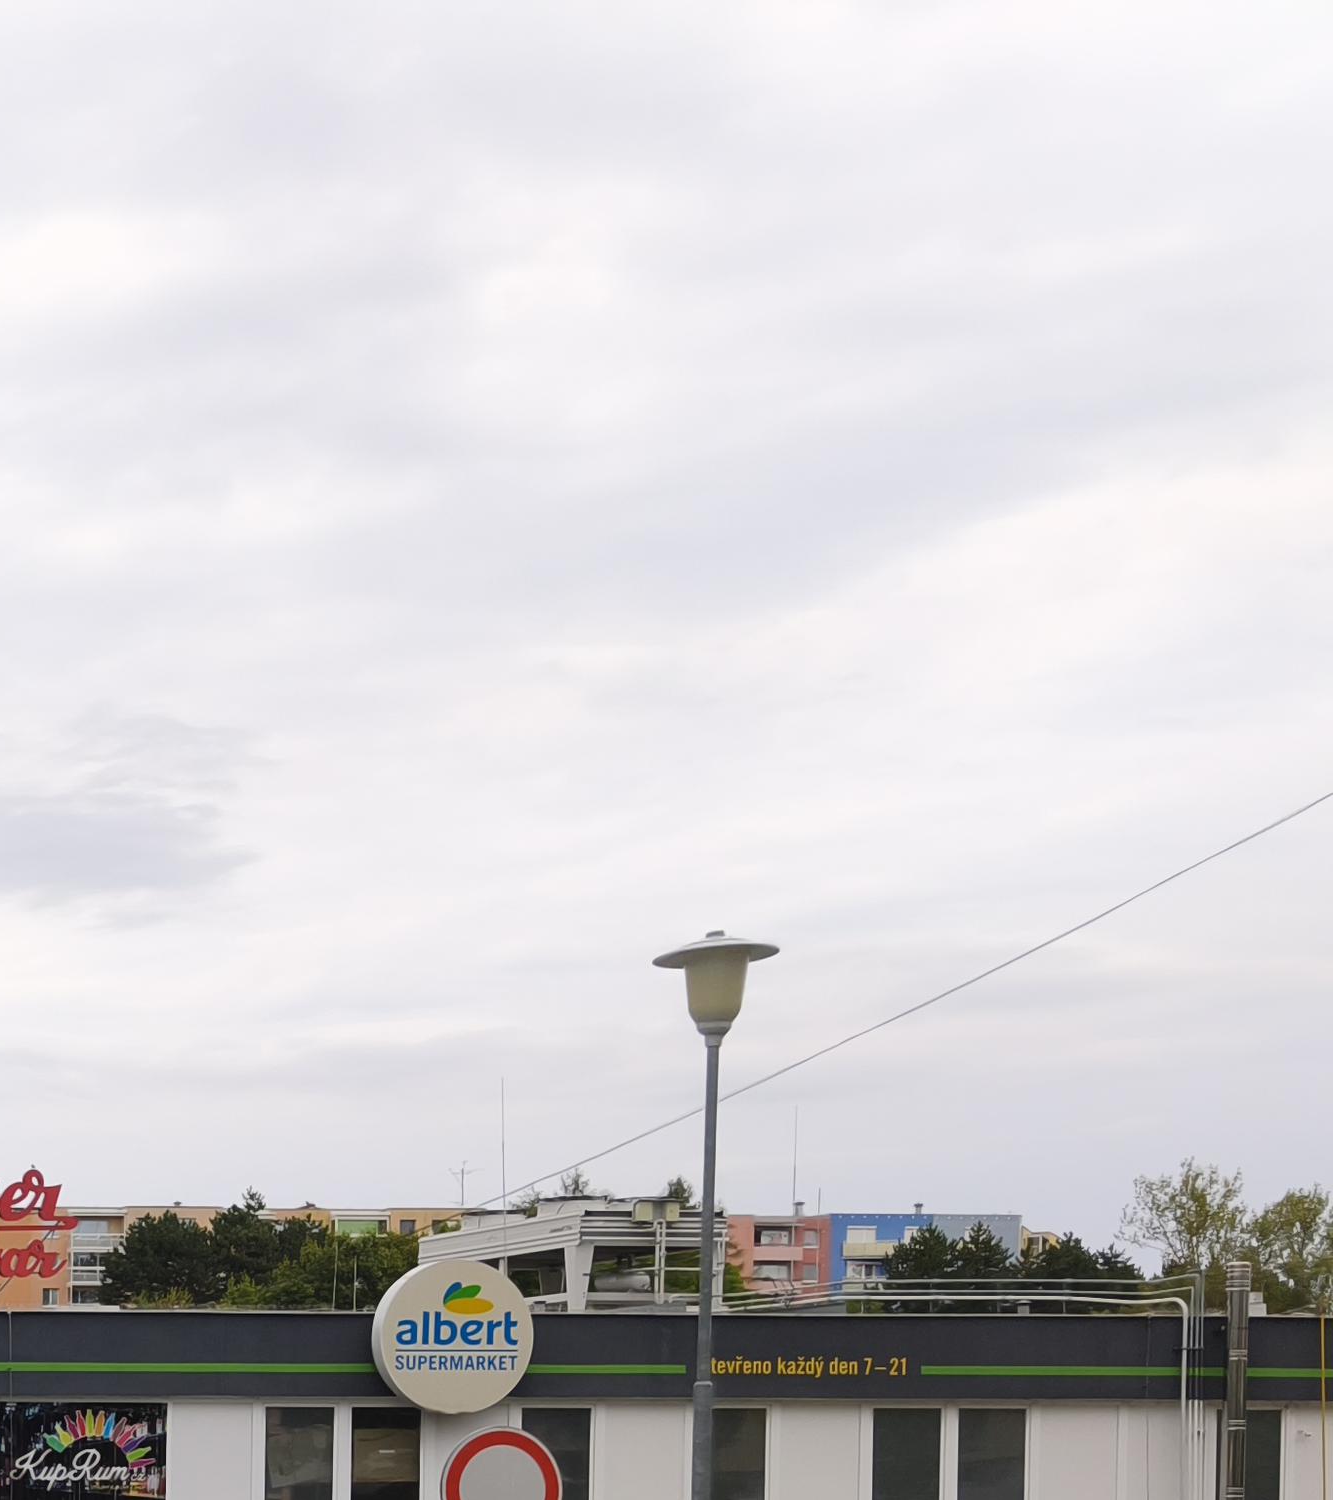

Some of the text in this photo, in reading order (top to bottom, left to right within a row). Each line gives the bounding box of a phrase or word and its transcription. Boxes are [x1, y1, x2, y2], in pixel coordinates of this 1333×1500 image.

[395, 1311, 519, 1346] albert
[395, 1355, 518, 1371] SUPERMARKET
[710, 1356, 772, 1375] tevřeno
[777, 1356, 824, 1379] každý
[830, 1358, 859, 1375] den
